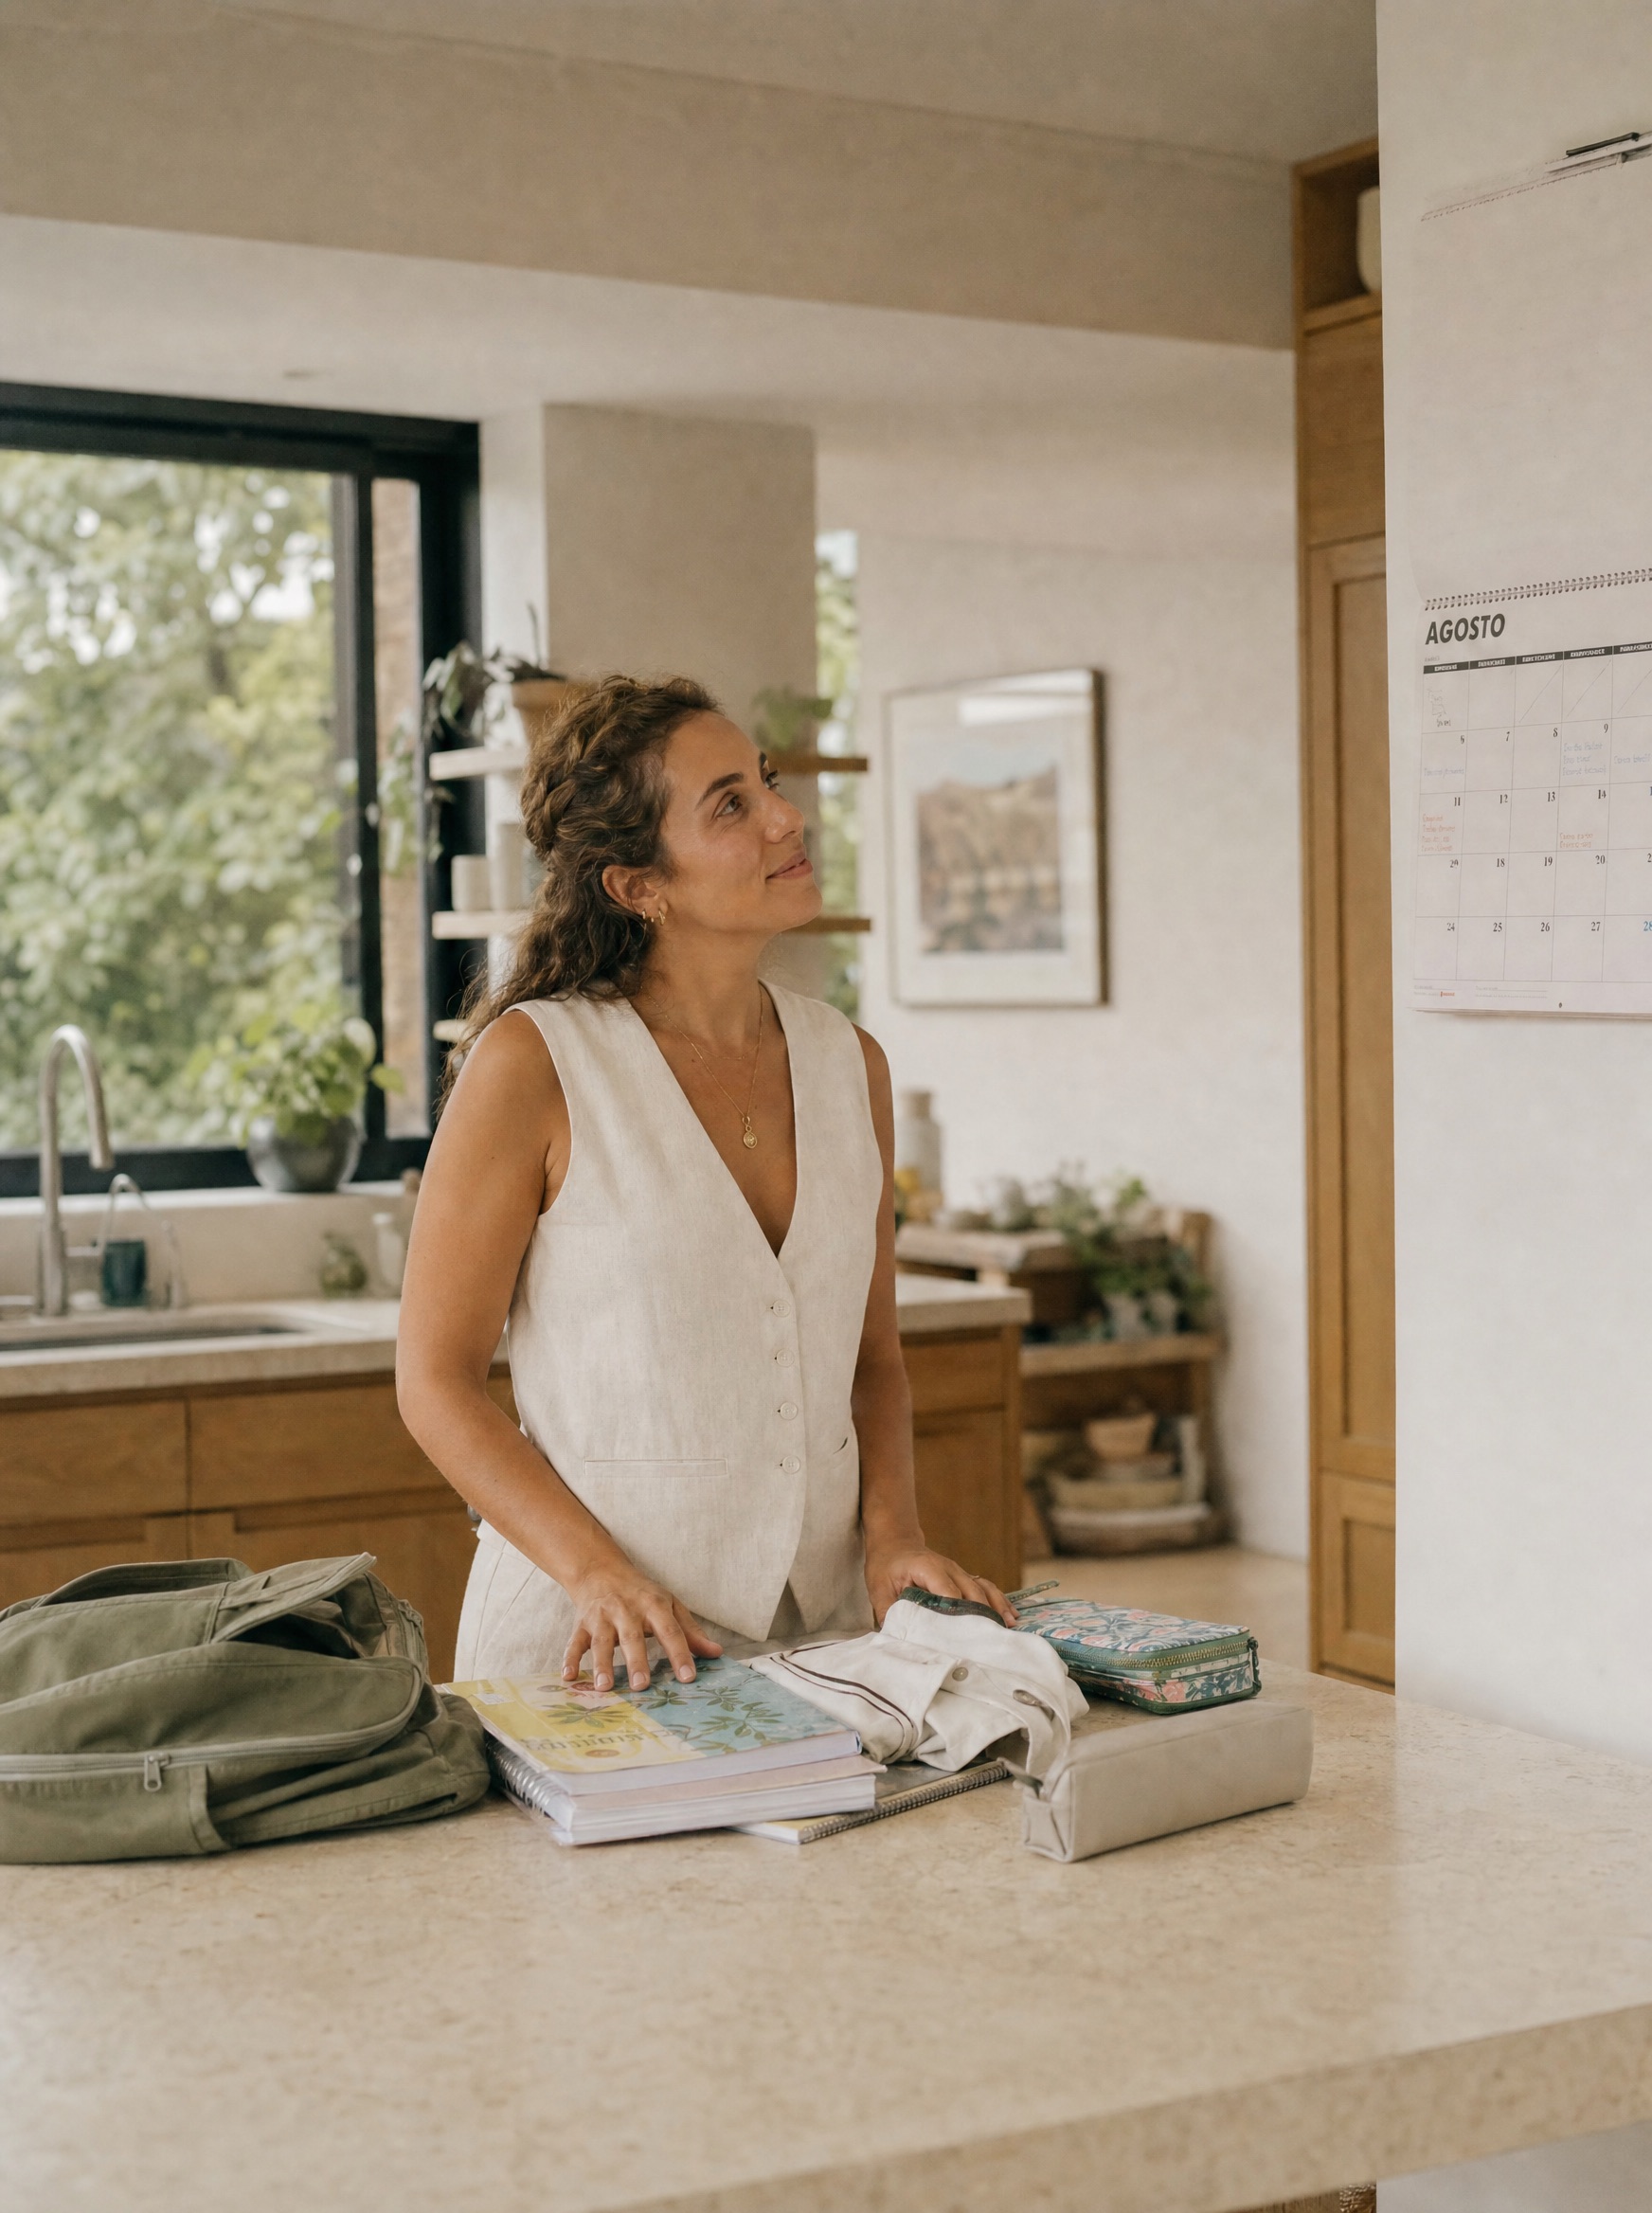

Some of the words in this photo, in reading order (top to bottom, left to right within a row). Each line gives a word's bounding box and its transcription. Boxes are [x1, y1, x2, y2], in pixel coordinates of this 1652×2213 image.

[1425, 613, 1506, 646] AGOSTO
[1553, 727, 1559, 738] 8
[1603, 723, 1609, 734] 9
[1505, 730, 1512, 742] 7
[1499, 793, 1509, 804] 12
[1547, 791, 1556, 802] 13
[1597, 789, 1607, 801] 14
[1454, 796, 1462, 807] 11
[1496, 857, 1505, 868] 18
[1544, 855, 1553, 867] 19
[1595, 854, 1606, 865] 20
[1446, 922, 1456, 933] 24
[1492, 922, 1503, 933] 25
[1540, 922, 1551, 933] 26
[1590, 921, 1601, 932] 27
